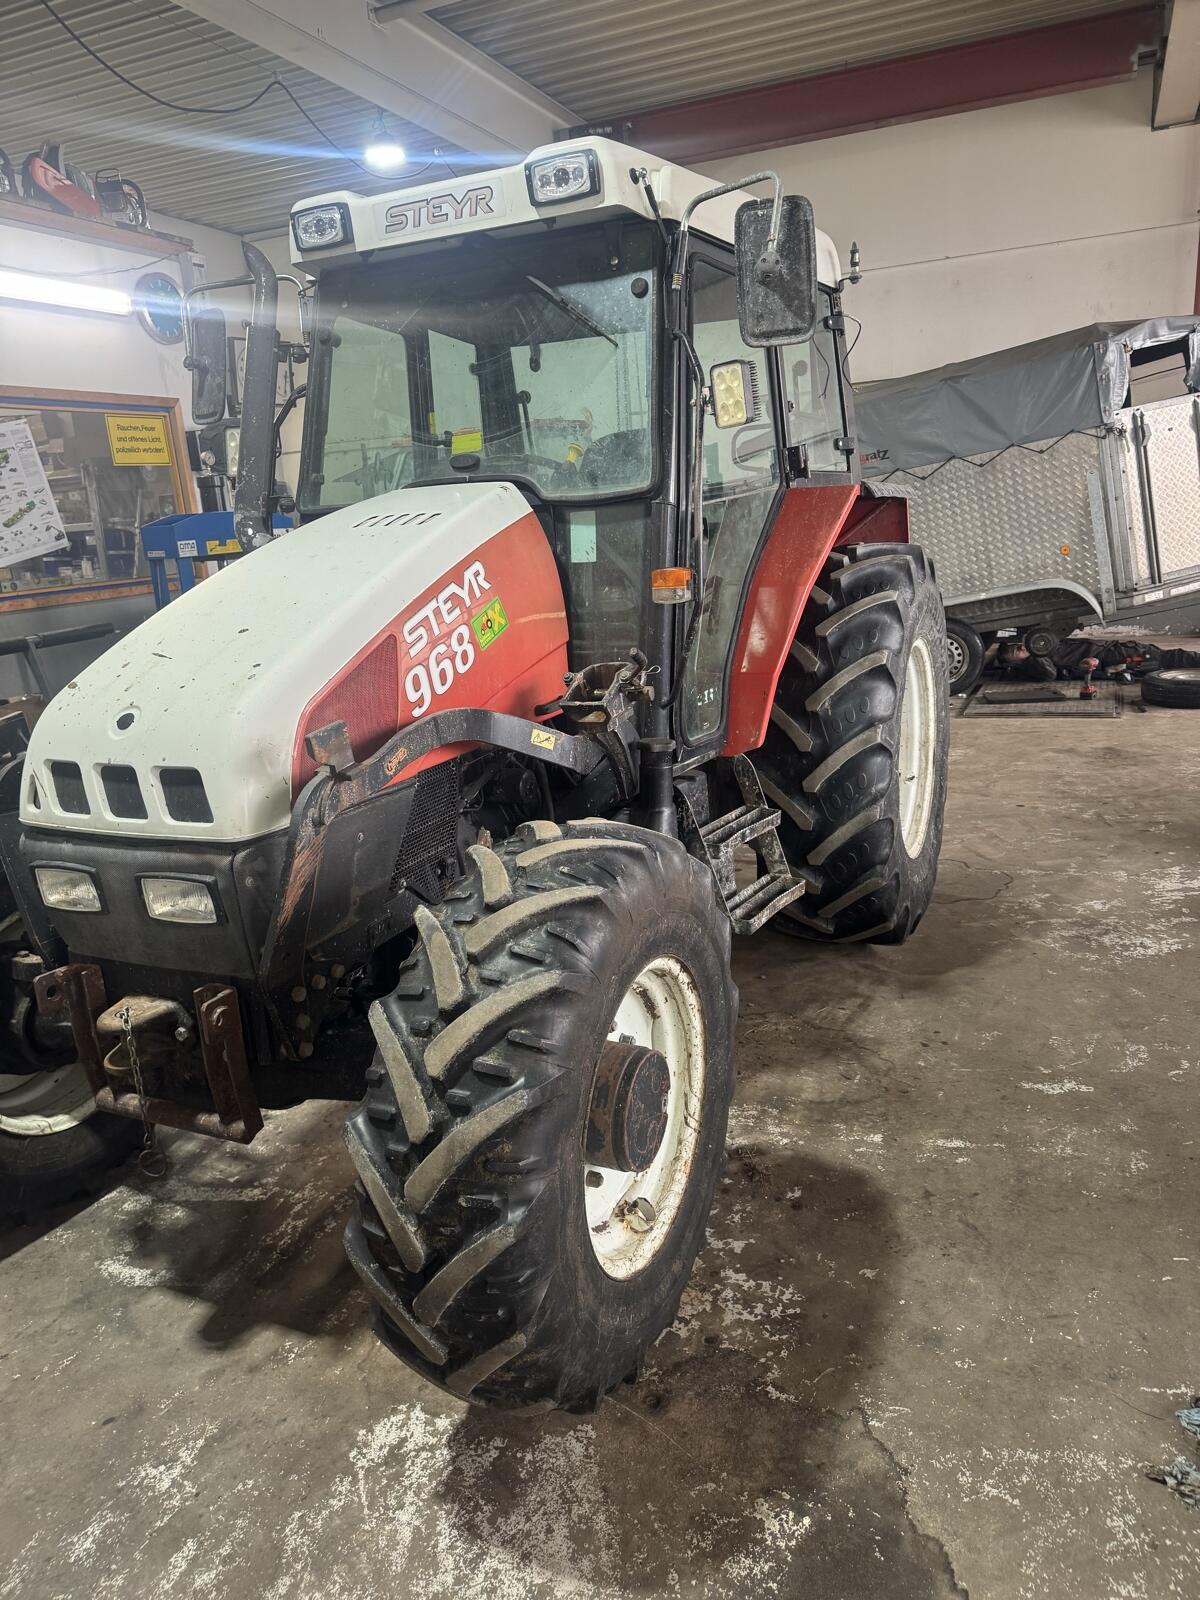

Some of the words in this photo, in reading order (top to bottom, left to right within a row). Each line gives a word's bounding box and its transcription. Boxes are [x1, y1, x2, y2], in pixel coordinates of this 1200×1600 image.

[385, 185, 495, 234] STEYR
[128, 435, 147, 443] offenes
[141, 424, 156, 432] Feuer
[116, 446, 141, 454] polizeilich
[143, 446, 164, 454] verboten!
[402, 560, 492, 658] STEYR
[403, 623, 476, 719] 968
